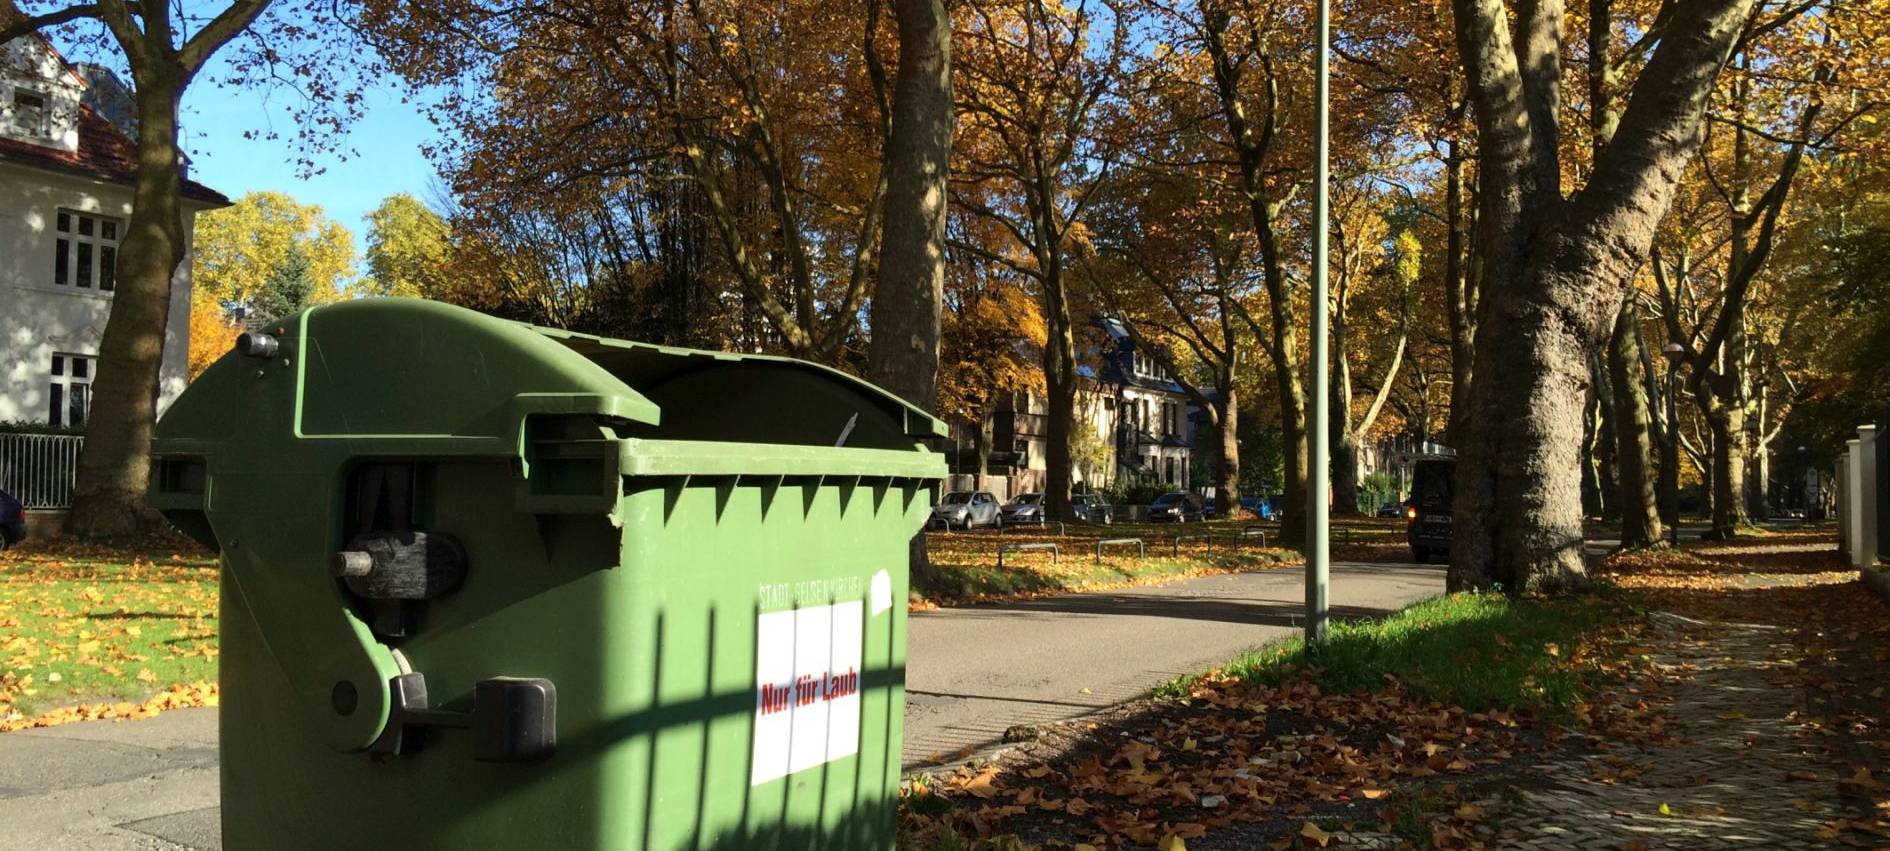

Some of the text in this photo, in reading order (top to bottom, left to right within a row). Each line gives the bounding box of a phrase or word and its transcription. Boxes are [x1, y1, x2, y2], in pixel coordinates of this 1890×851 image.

[760, 576, 862, 609] STADT GELSENKIRCHEN
[762, 666, 857, 716] Nur für Laub
